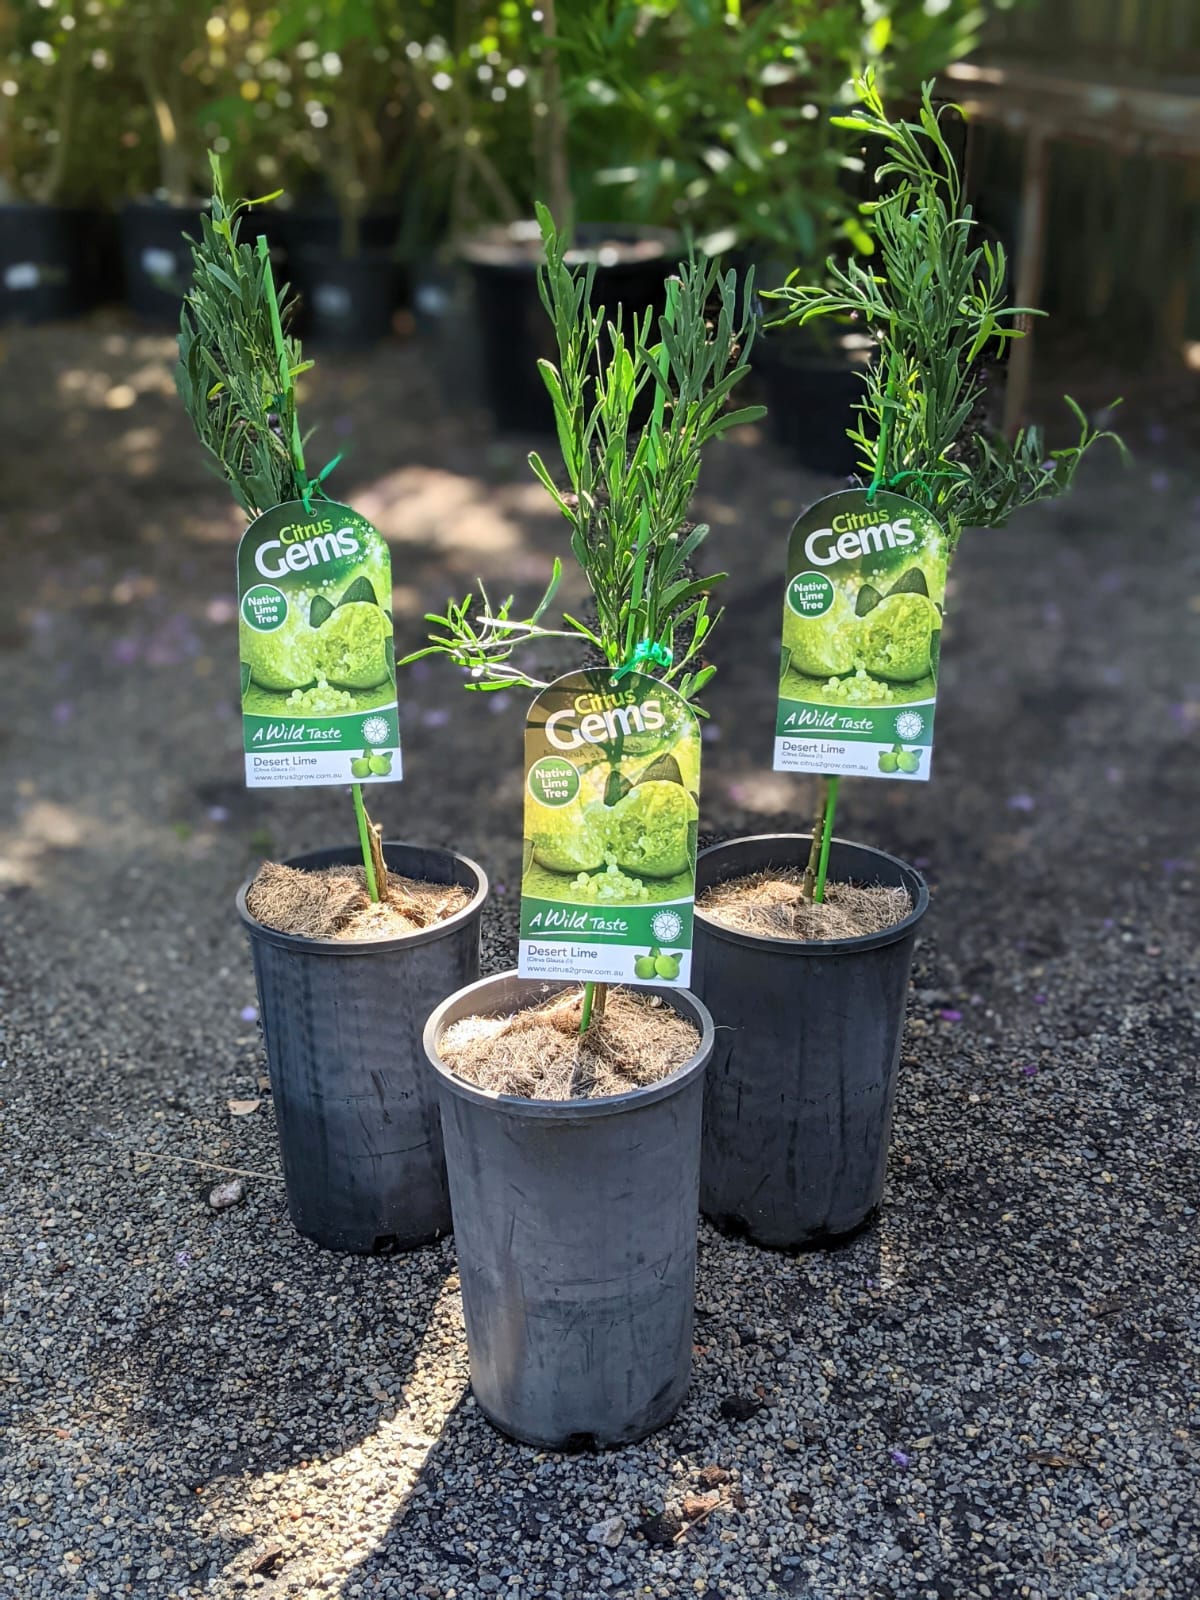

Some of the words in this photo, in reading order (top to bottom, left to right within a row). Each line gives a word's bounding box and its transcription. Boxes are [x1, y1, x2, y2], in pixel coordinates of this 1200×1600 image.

[832, 509, 890, 533] Citrus
[280, 519, 333, 545] Citrus
[804, 518, 915, 566] Gems
[255, 528, 359, 578] Gems
[794, 582, 828, 592] Native
[248, 595, 281, 606] Native
[800, 591, 824, 601] Lime
[254, 606, 278, 615] Lime
[800, 601, 823, 610] Tree
[256, 615, 278, 624] Tree
[574, 689, 636, 715] Citrus
[545, 700, 666, 750] Gems
[784, 712, 796, 726] A
[797, 709, 838, 728] Wild
[838, 717, 875, 730] Taste
[252, 727, 263, 741] A
[266, 723, 303, 740] Wild
[306, 728, 342, 739] Taste
[782, 741, 818, 752] Desert
[820, 743, 846, 754] Lime
[253, 757, 289, 767] Desert
[292, 756, 318, 765] Lime
[781, 759, 869, 770] www.citrus2grow.com.au
[254, 772, 342, 781] www.citrus2grow.com.au
[535, 768, 573, 779] Native
[541, 779, 569, 789] Lime
[544, 788, 569, 798] Tree
[528, 912, 543, 928] A
[544, 908, 589, 929] Wild
[590, 917, 629, 931] Taste
[527, 944, 568, 957] Desert
[570, 947, 598, 959] Lime
[526, 965, 624, 977] www.citrus2grow.com.au
